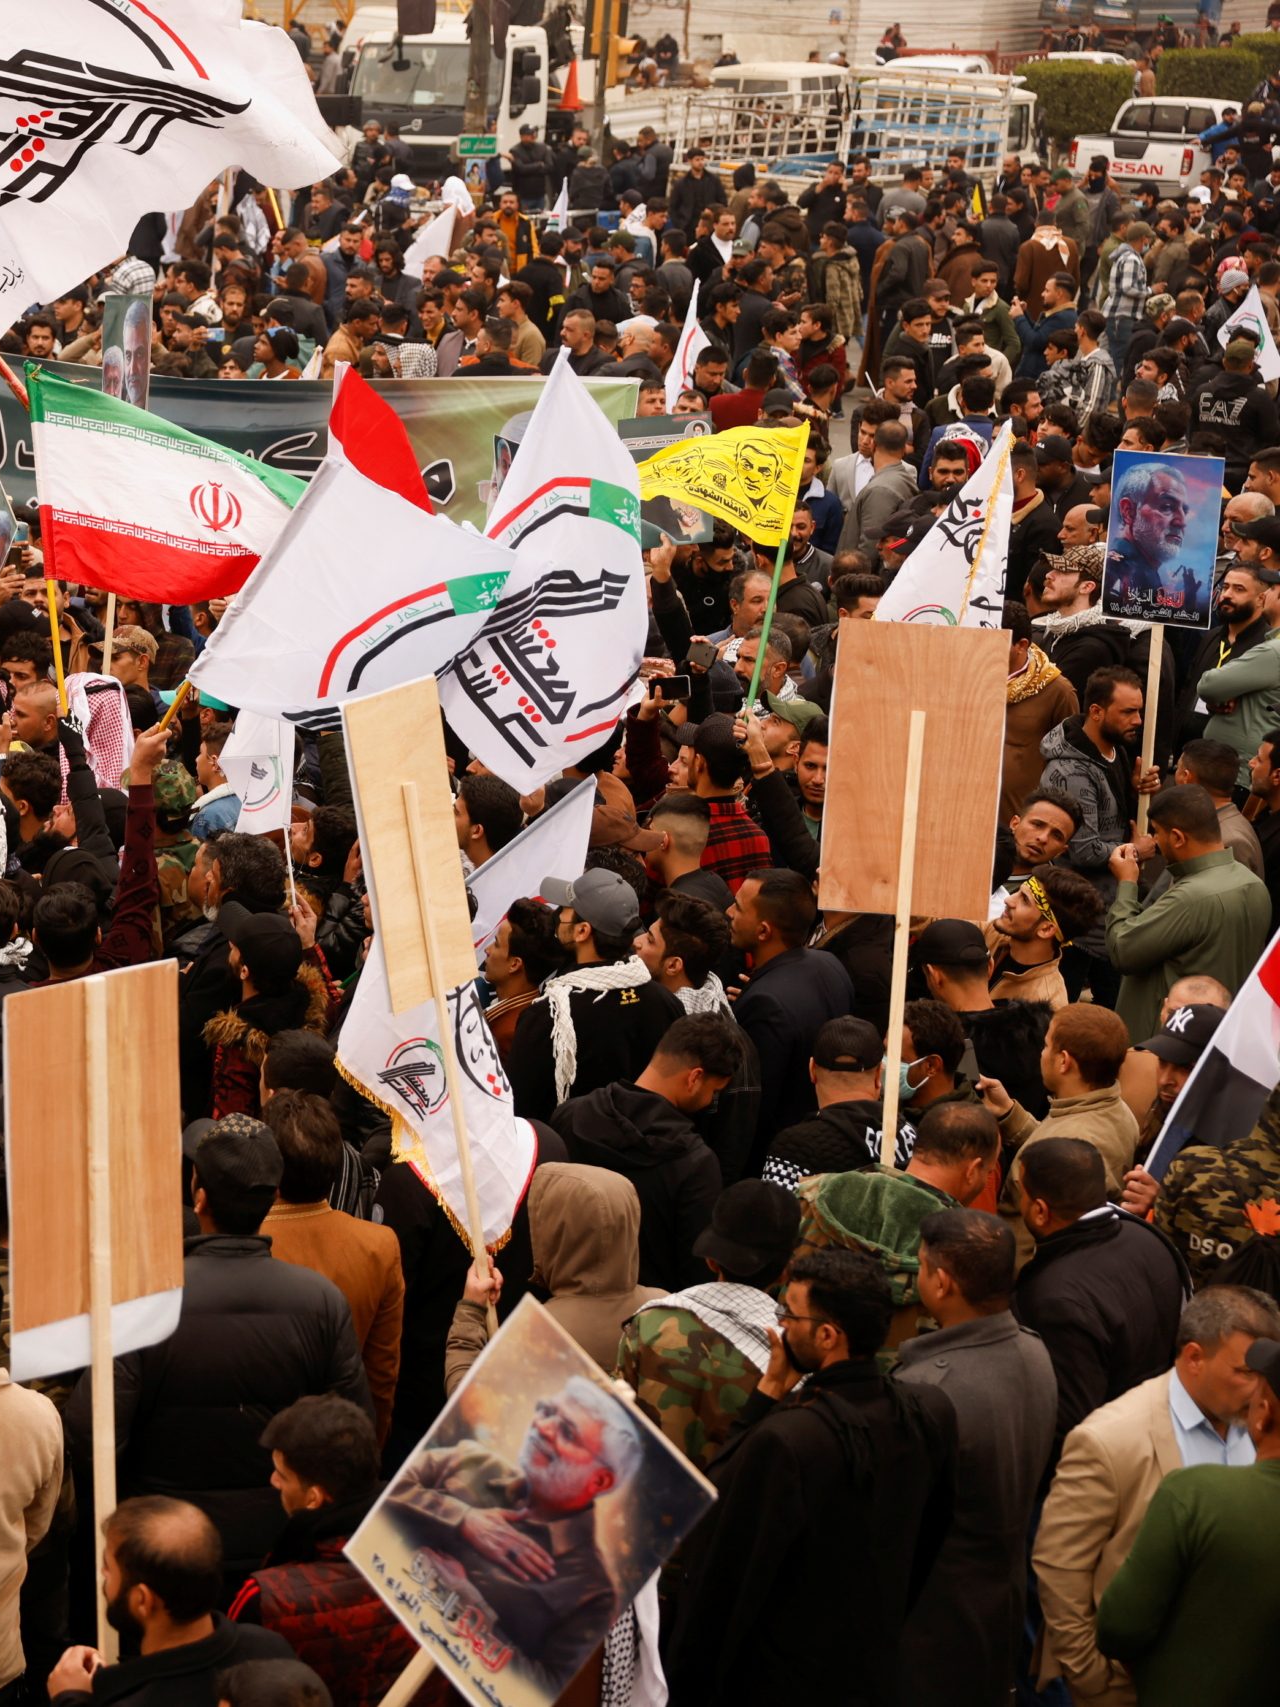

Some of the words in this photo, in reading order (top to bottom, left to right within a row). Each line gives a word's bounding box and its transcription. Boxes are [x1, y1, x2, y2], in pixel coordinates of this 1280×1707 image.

[1105, 161, 1164, 176] ISSAN
[1199, 392, 1248, 420] EA7
[385, 1576, 422, 1615] اللواء
[420, 1620, 471, 1671] الشعبي
